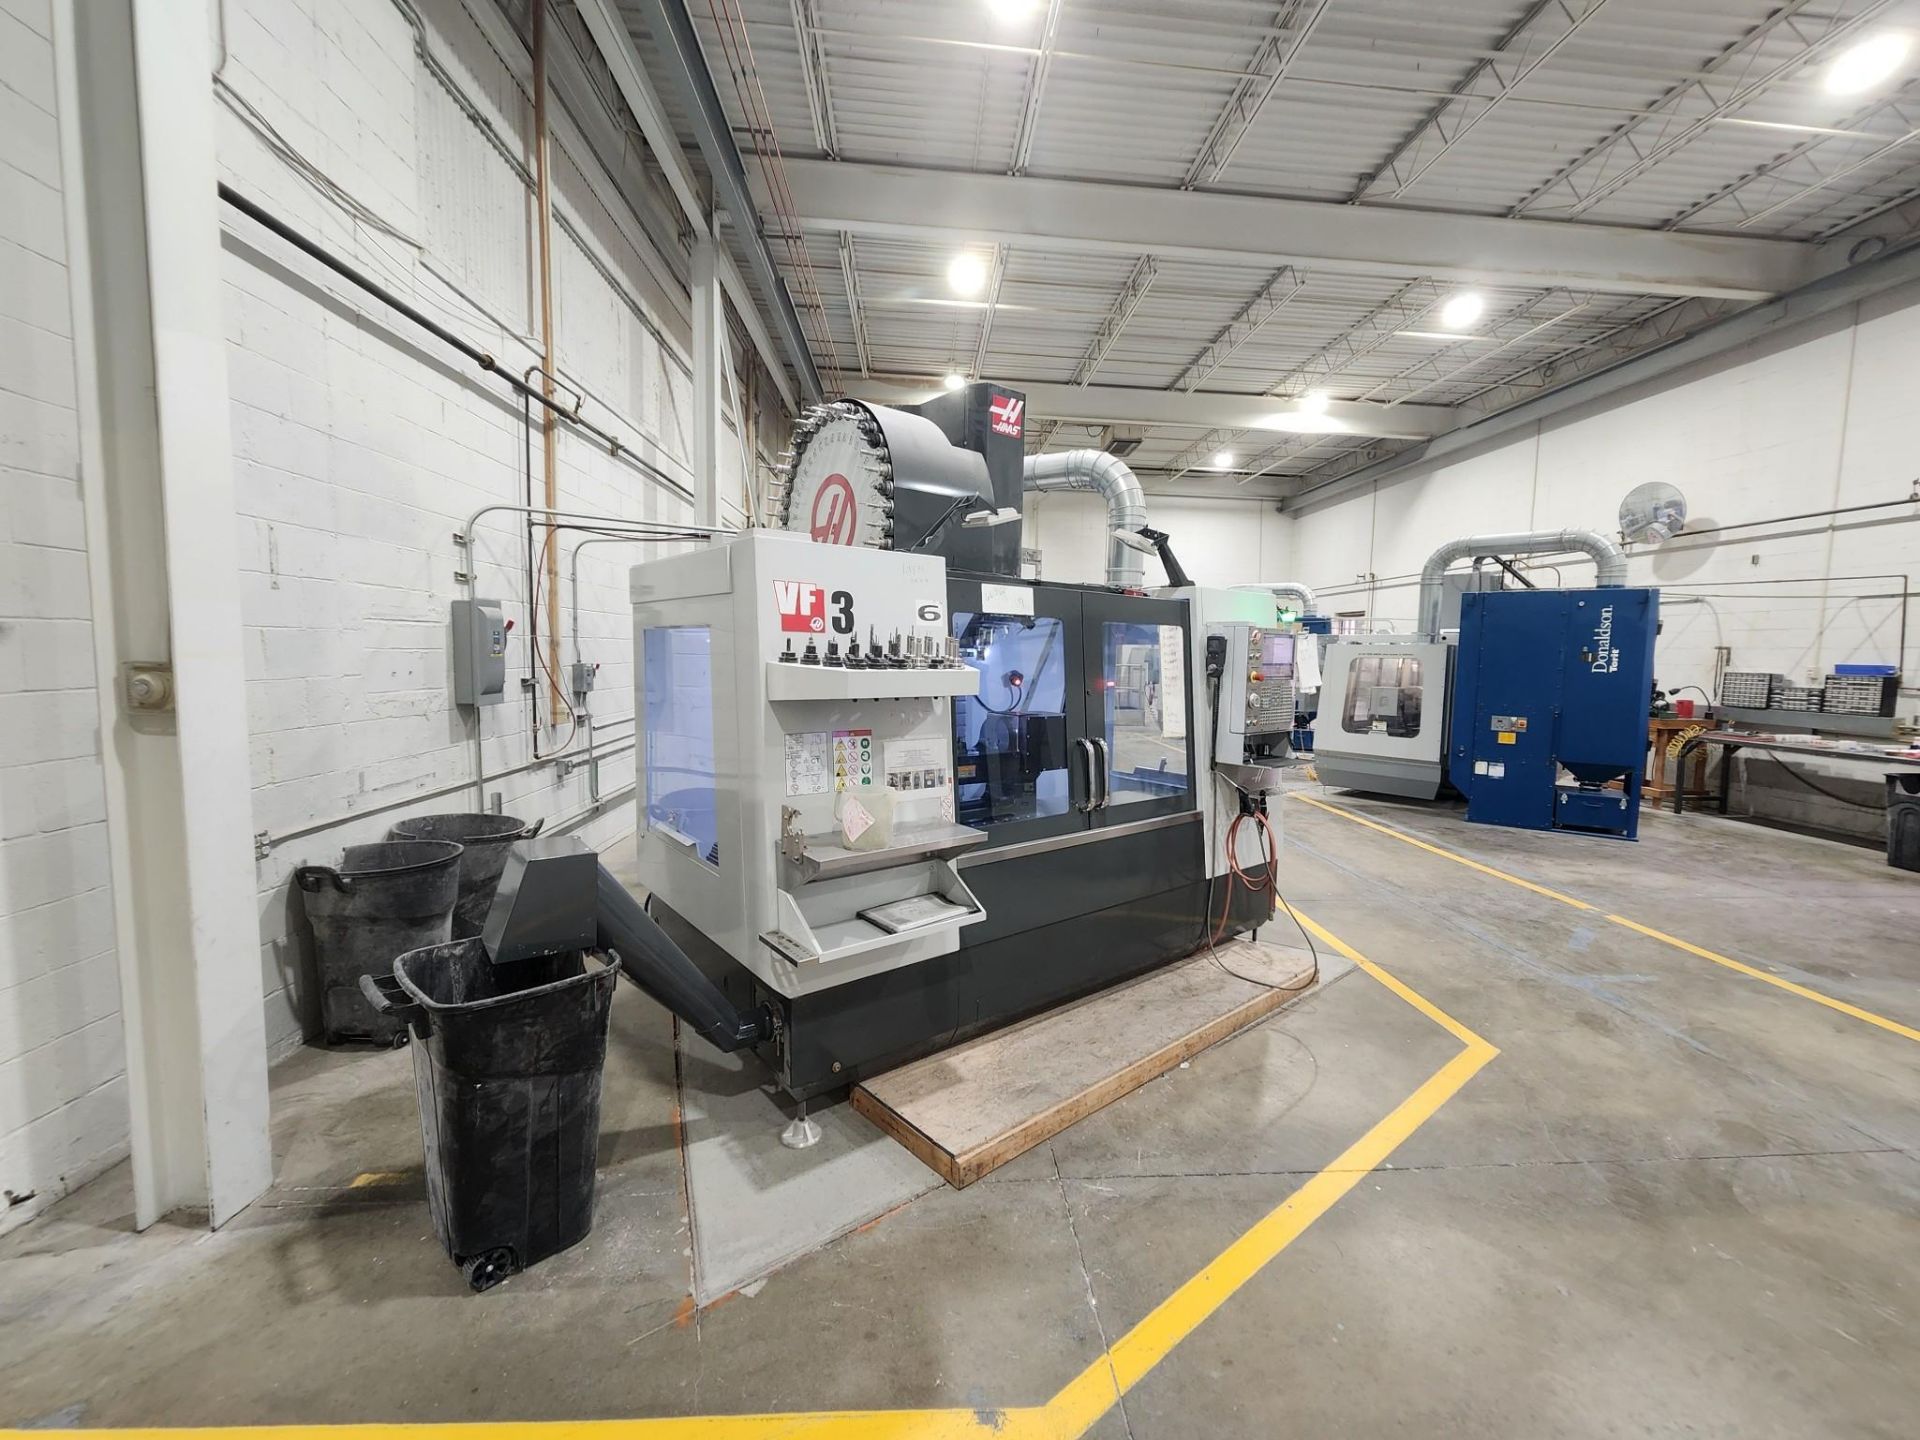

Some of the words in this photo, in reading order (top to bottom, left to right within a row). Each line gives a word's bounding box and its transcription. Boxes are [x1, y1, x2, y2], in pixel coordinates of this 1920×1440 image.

[991, 421, 1021, 436] HAAS
[772, 580, 817, 616] VF
[830, 590, 855, 635] 3
[917, 604, 942, 622] 6
[1609, 649, 1620, 673] Torit
